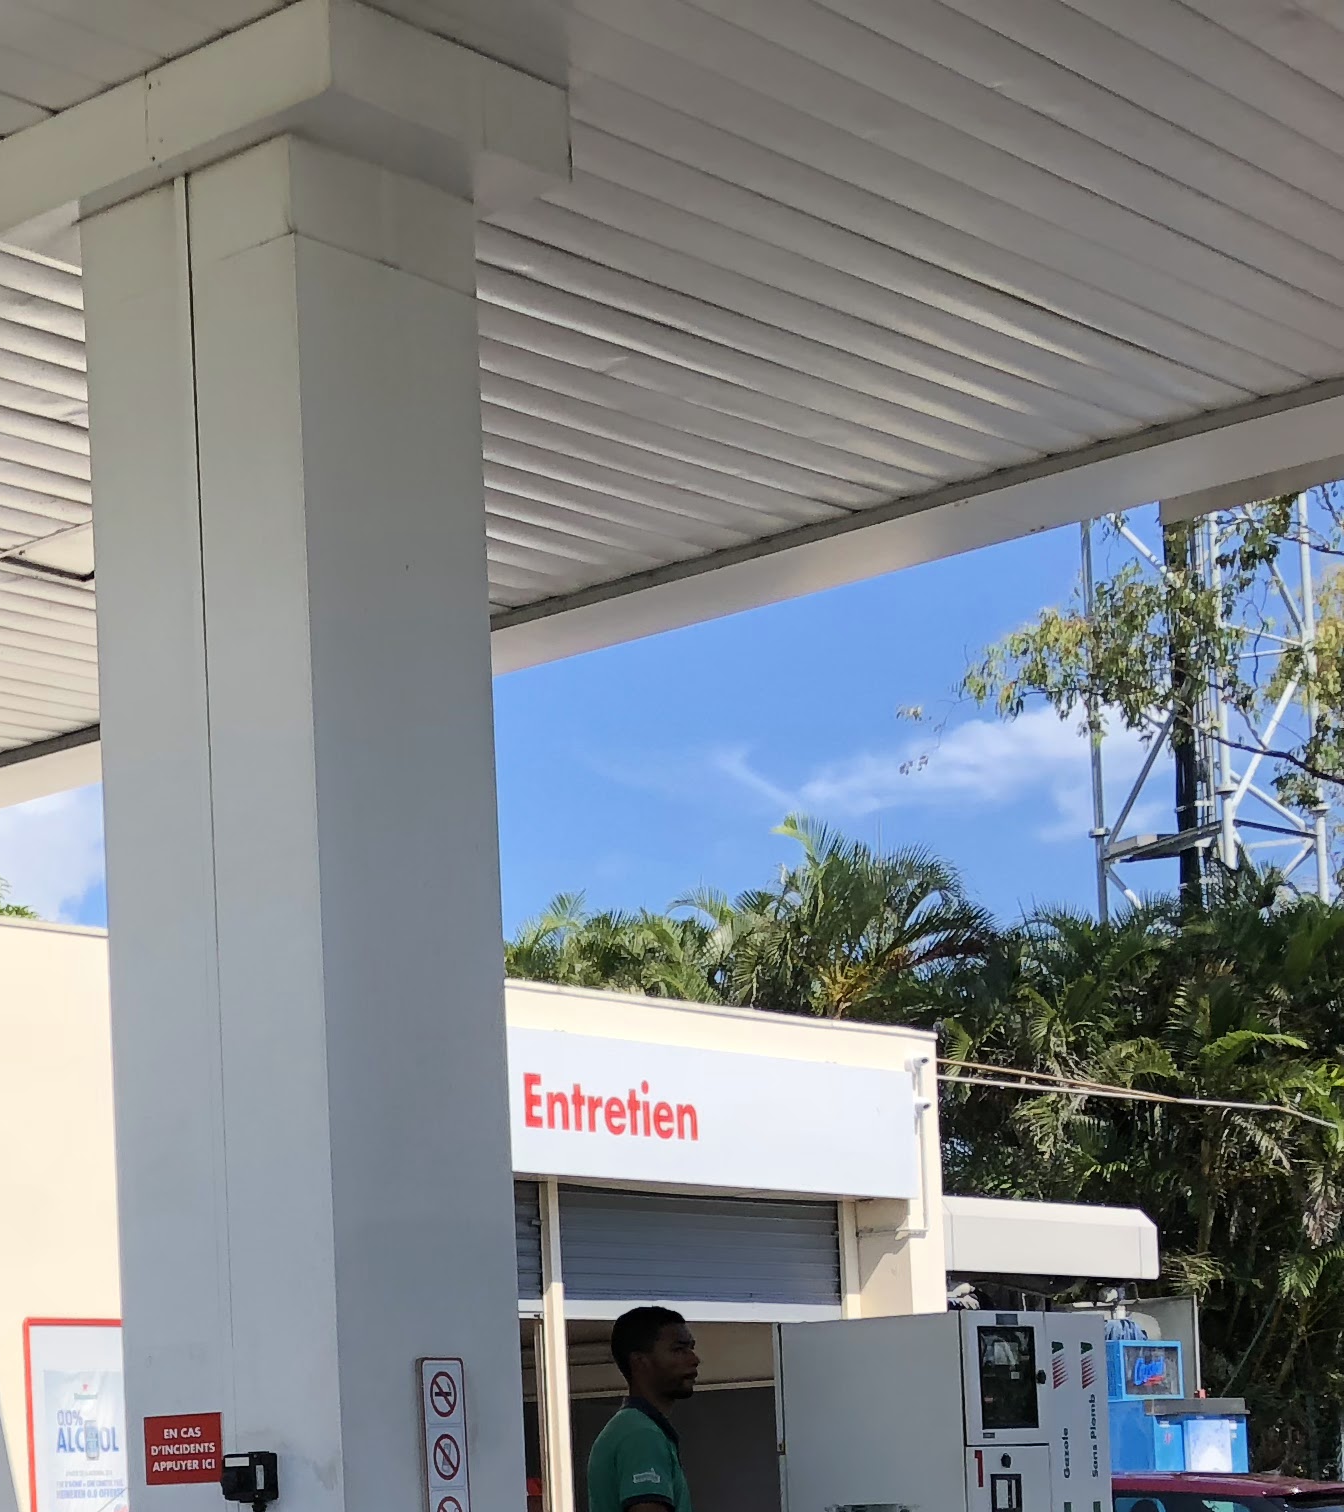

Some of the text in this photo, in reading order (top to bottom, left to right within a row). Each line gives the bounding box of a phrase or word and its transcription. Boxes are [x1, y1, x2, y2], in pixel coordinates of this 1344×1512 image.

[523, 1071, 699, 1141] Entretien
[163, 1426, 202, 1439] EN CAS
[151, 1442, 216, 1456] D'INCIDENTS
[1091, 1444, 1099, 1478] Sans
[152, 1459, 216, 1472] APPUYER ICI
[974, 1450, 984, 1488] 1
